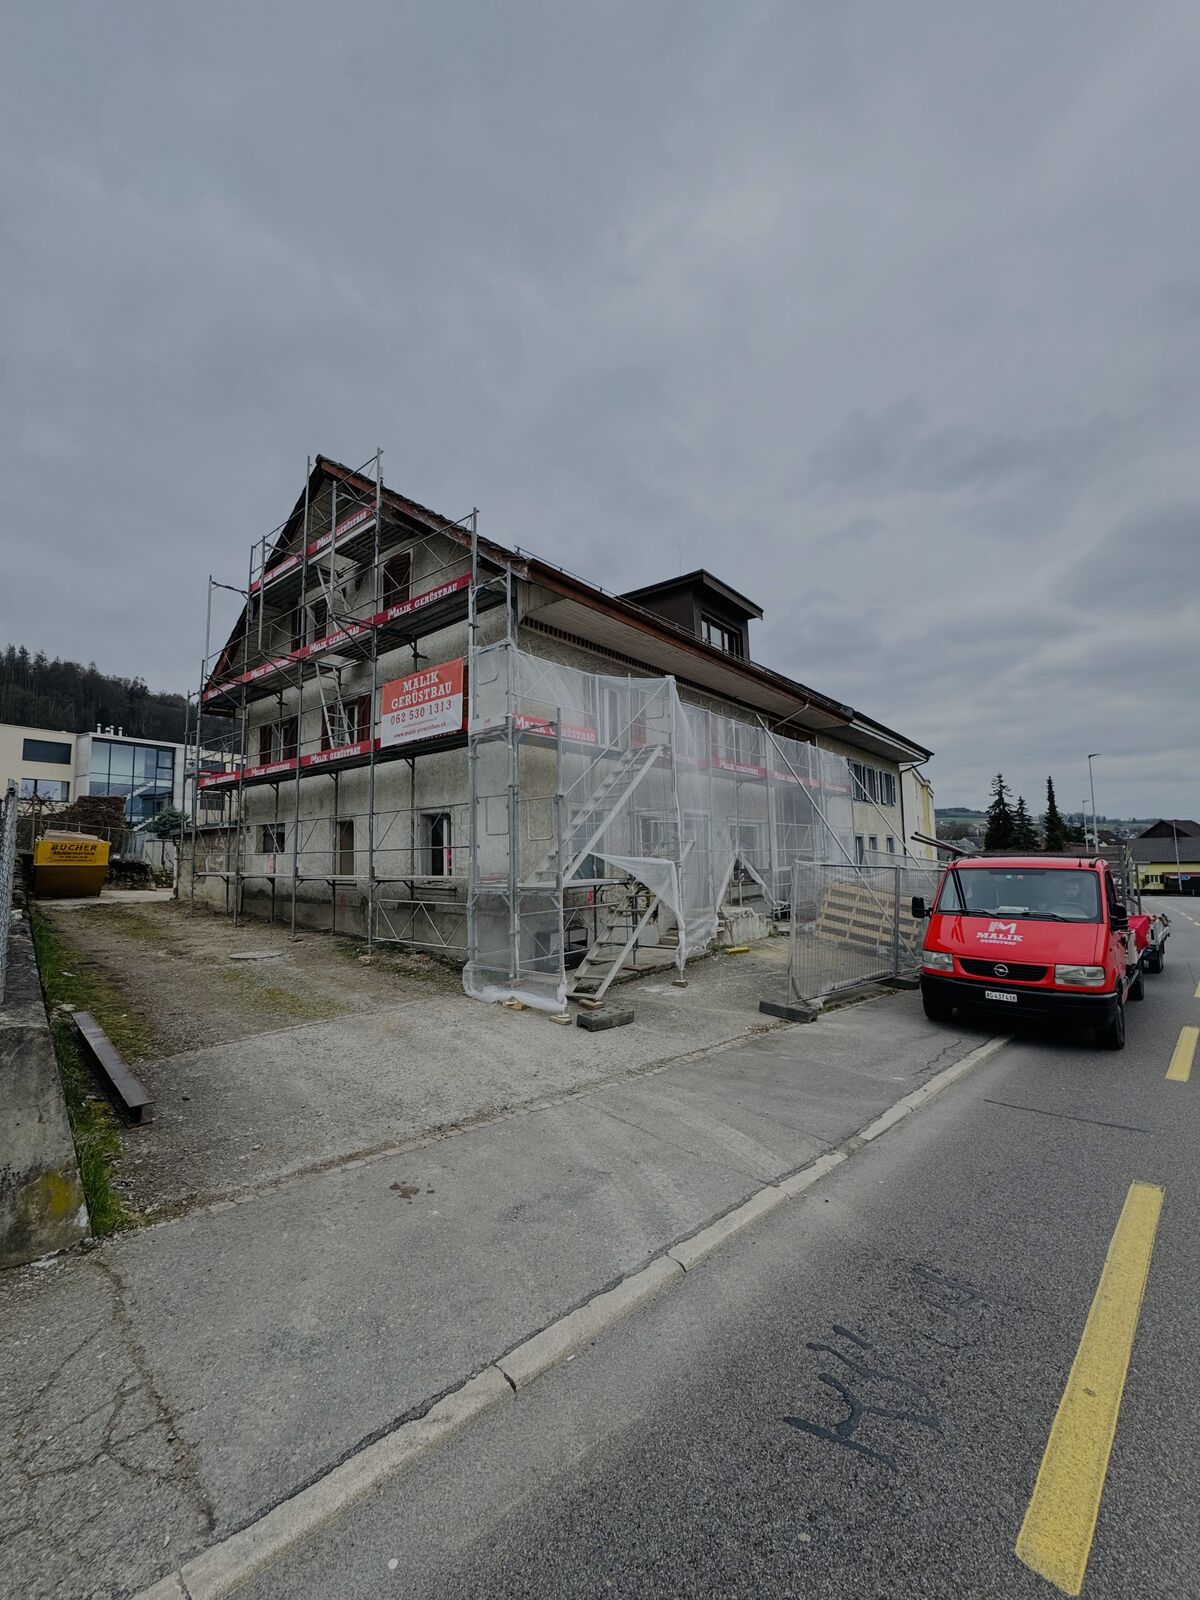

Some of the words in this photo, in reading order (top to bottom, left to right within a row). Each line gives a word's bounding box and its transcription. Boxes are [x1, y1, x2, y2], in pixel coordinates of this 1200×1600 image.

[387, 603, 412, 620] MALIK
[414, 583, 458, 608] GERÜSTBAU
[402, 671, 439, 692] MALIK
[391, 681, 453, 710] GERÜSTBAU
[390, 712, 406, 726] 062
[408, 707, 425, 721] 530
[428, 699, 452, 716] 1313
[976, 931, 1024, 942] MALIK
